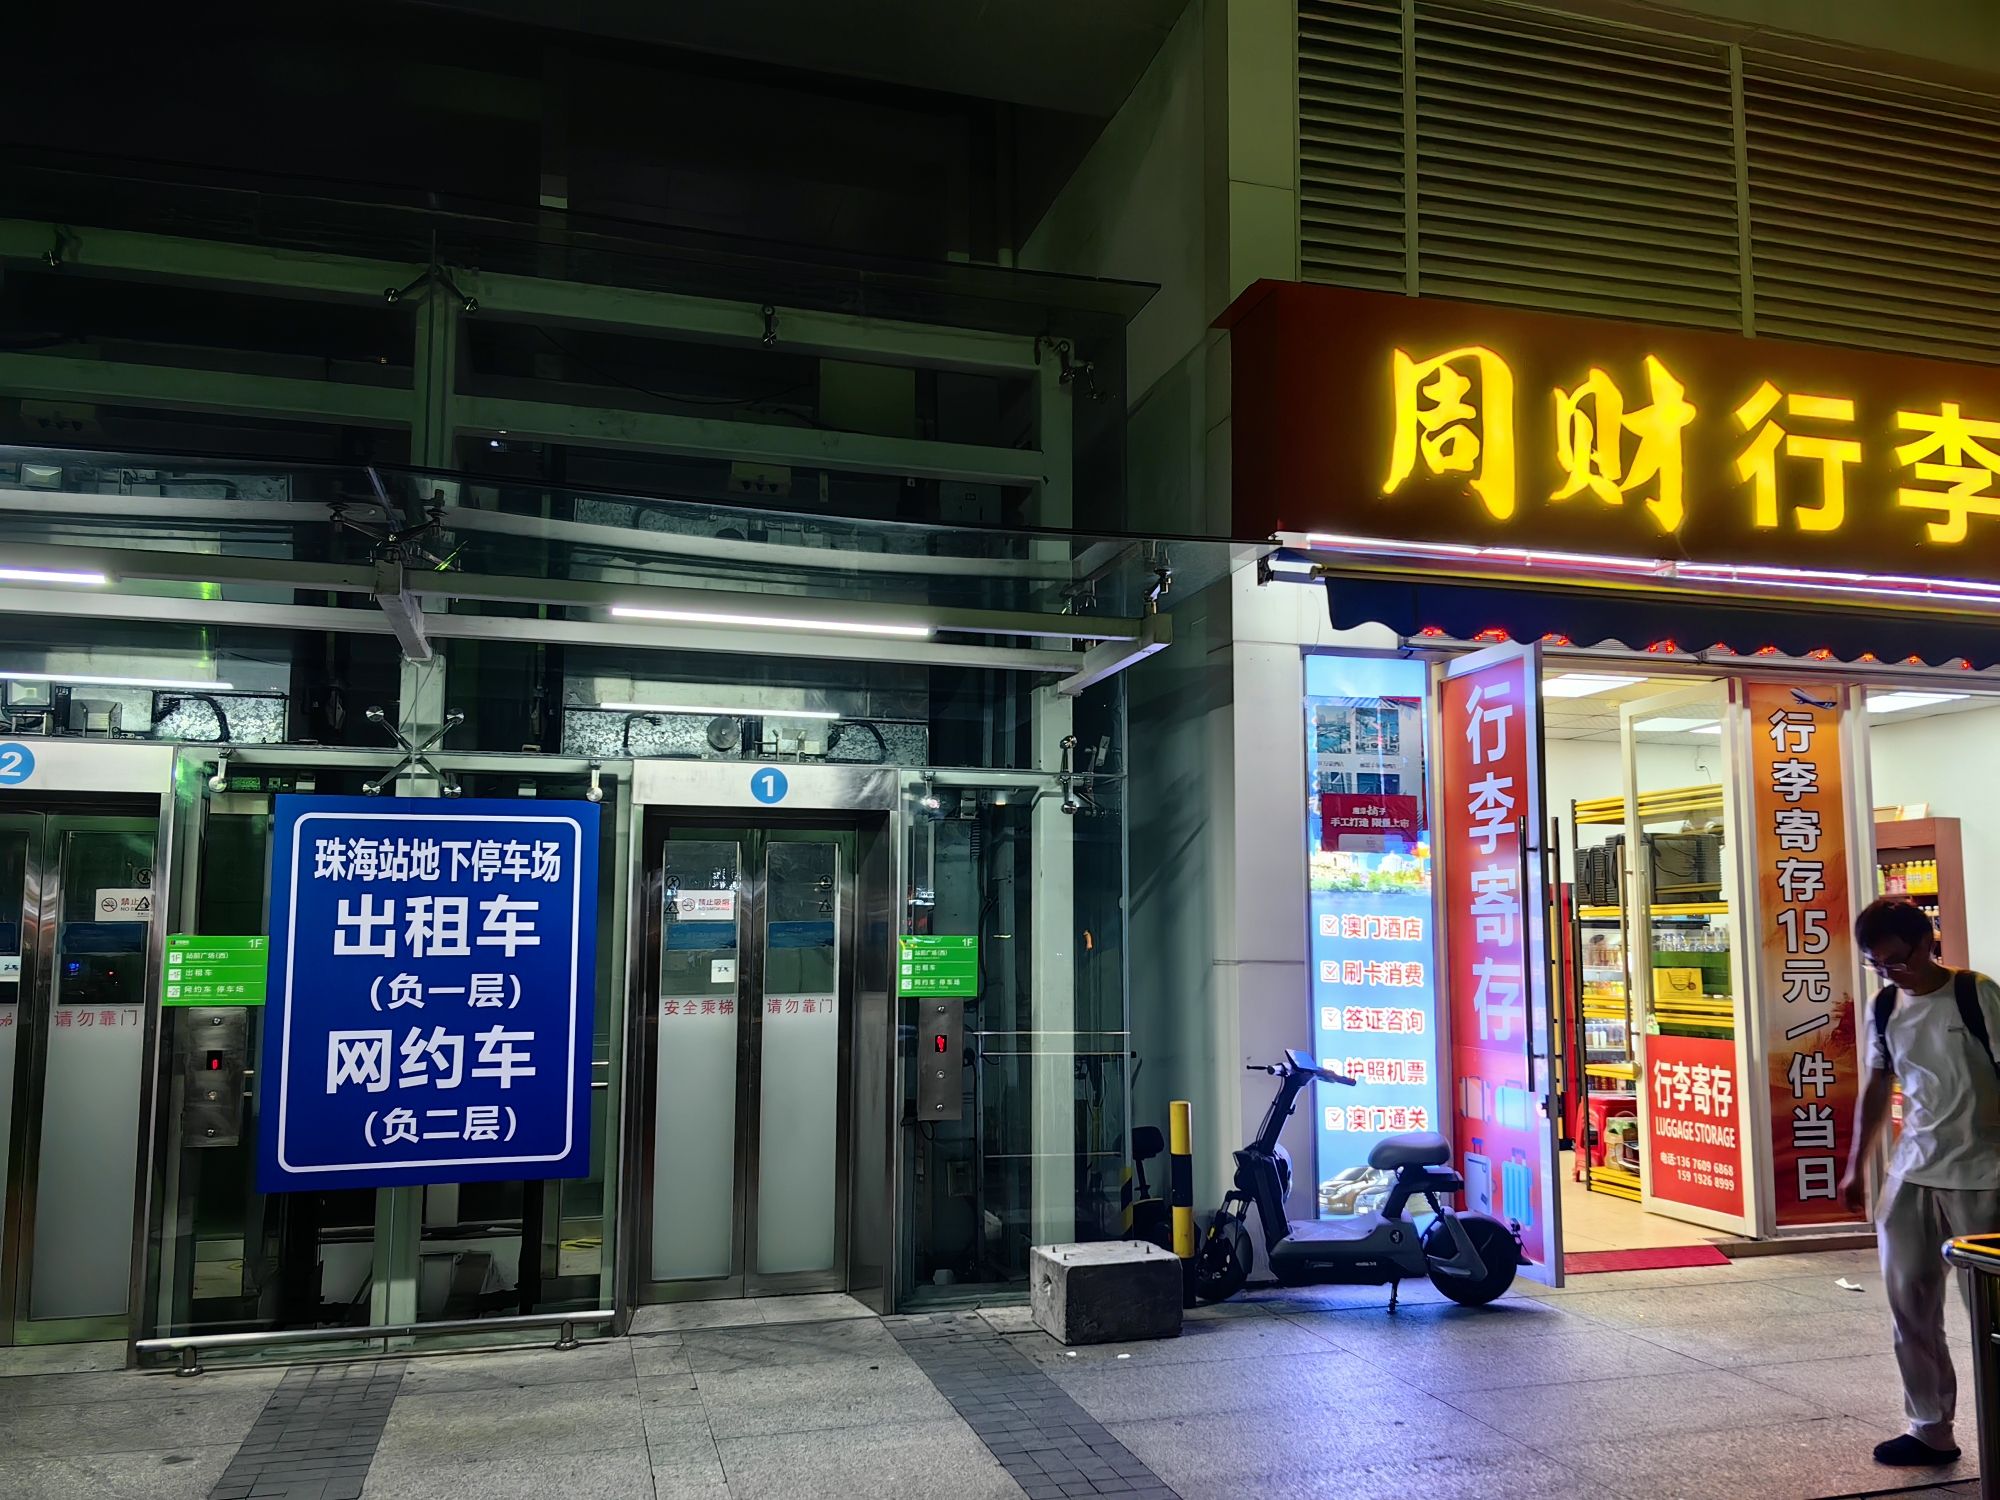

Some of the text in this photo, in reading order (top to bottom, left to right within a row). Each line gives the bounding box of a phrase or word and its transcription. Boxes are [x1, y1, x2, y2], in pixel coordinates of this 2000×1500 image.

[1382, 345, 2000, 544] 周财行李
[0, 751, 22, 777] 2
[761, 775, 774, 797] 1
[314, 837, 561, 883] 珠海站地下停车场
[1466, 681, 1521, 1041] 行李寄存
[333, 893, 541, 958] 出租车
[1342, 915, 1422, 940] 澳门酒店
[248, 938, 263, 949] 1F
[961, 937, 973, 947] 1F
[1343, 961, 1424, 987] 刷卡消费
[370, 973, 522, 1011] (负一层)
[54, 1009, 138, 1028] 请勿靠门
[664, 999, 734, 1016] 安全乘梯
[767, 998, 834, 1014] 请勿靠门
[1345, 1007, 1425, 1033] 签证咨询
[326, 1024, 537, 1094] 网约车
[1346, 1058, 1426, 1083] 护照机票
[1653, 1059, 1733, 1118] 行李寄存
[364, 1105, 517, 1147] (负二层)
[1348, 1106, 1428, 1131] 澳门通关
[1655, 1116, 1736, 1148] LUGGAGE STORAGE
